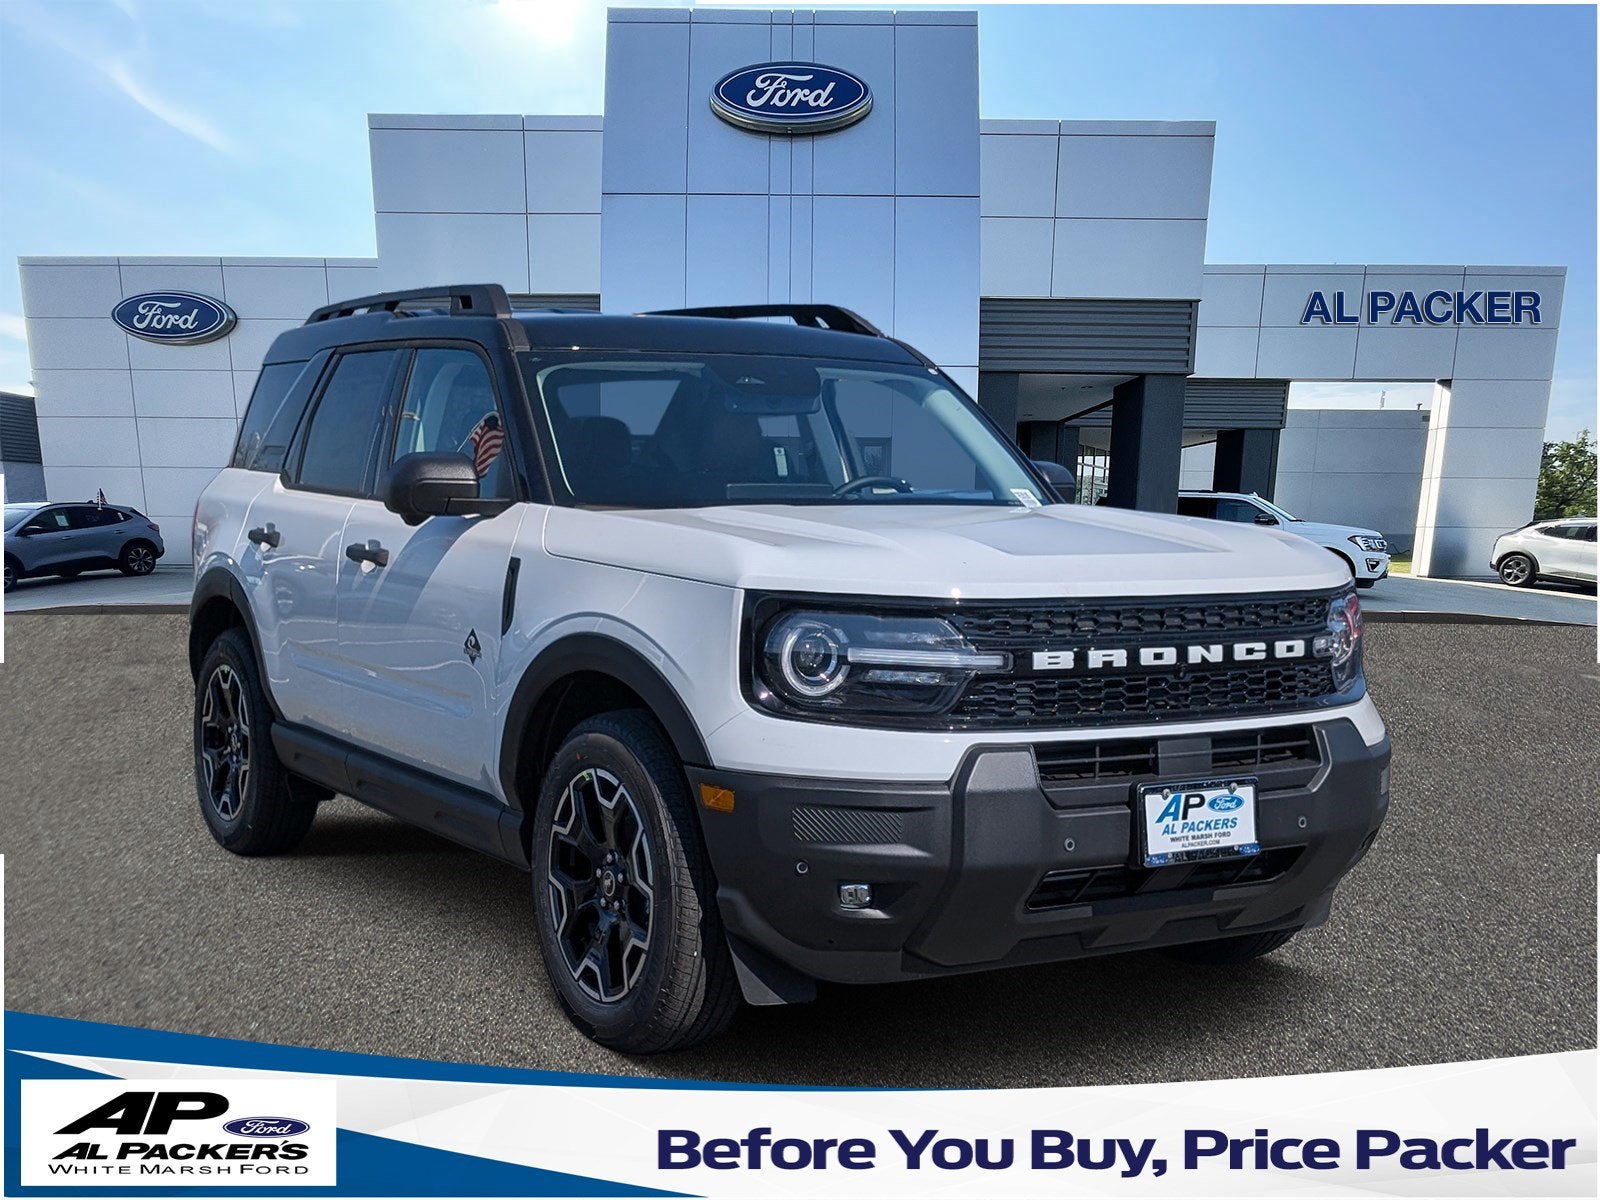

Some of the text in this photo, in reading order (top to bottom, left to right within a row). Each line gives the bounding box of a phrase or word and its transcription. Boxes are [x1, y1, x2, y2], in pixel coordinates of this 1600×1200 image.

[746, 73, 836, 107] Ford
[133, 301, 199, 329] Ford
[1302, 290, 1542, 324] AL PACKER
[1032, 639, 1306, 670] BRONCO
[1155, 793, 1206, 824] AP
[1213, 797, 1238, 811] Ford
[1162, 817, 1238, 836] AL PACKERS
[1170, 831, 1231, 844] WHITE MARSH FORD
[1181, 839, 1221, 849] ALPACKER.COM
